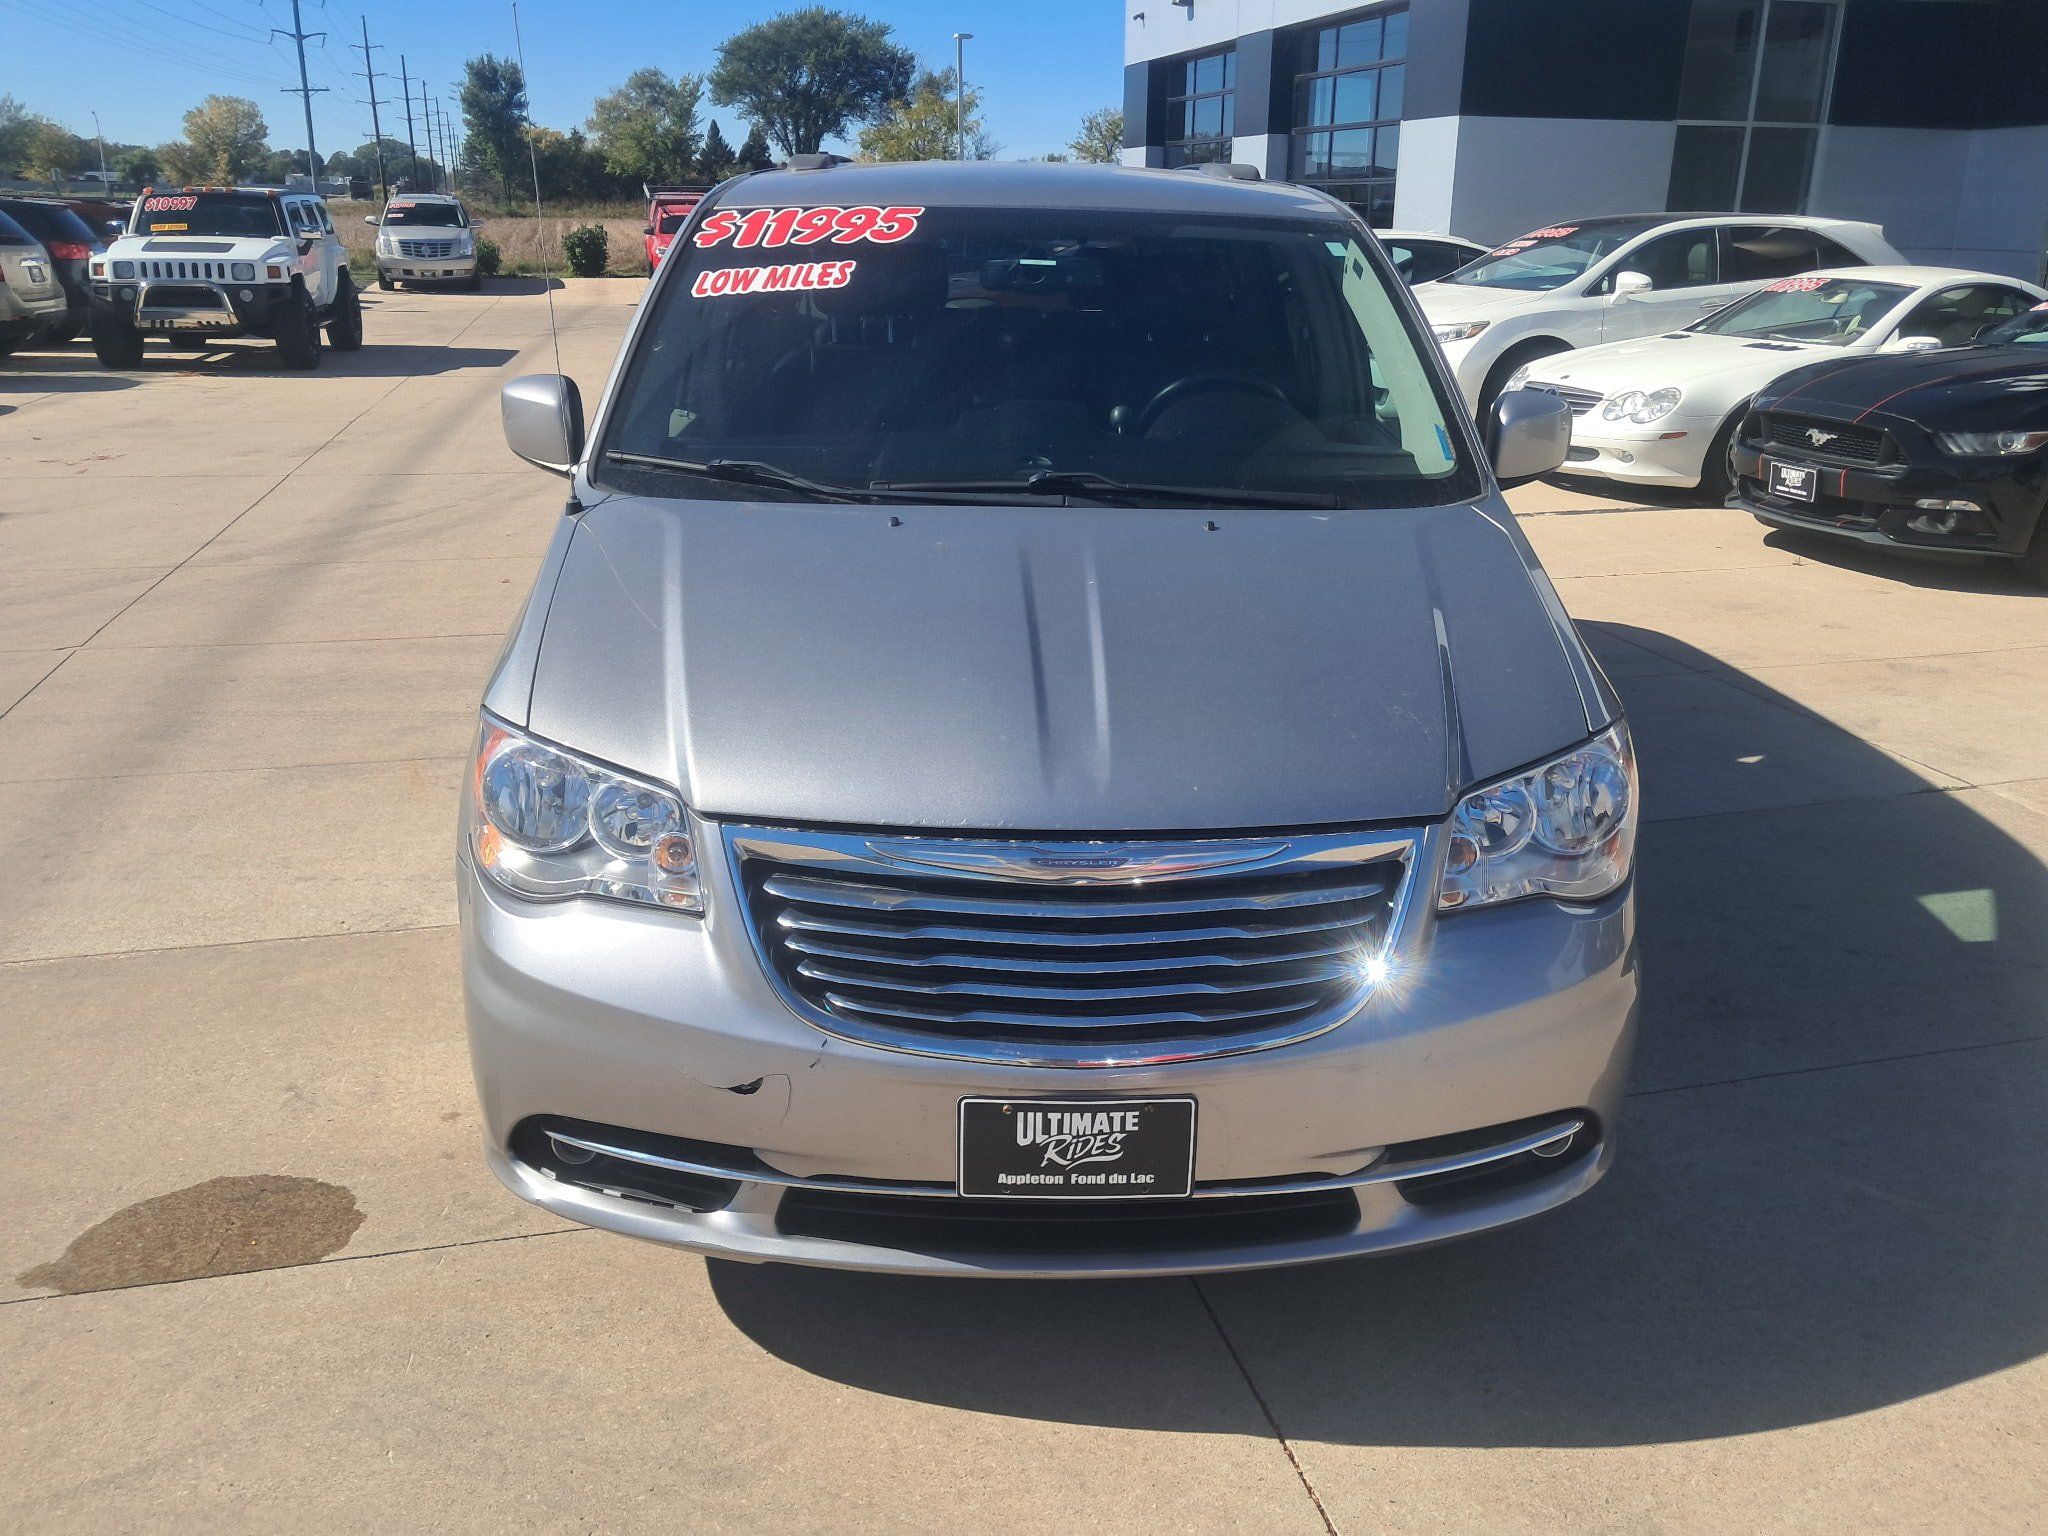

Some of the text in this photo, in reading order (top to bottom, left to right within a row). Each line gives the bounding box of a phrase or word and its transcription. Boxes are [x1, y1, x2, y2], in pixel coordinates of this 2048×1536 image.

[144, 196, 197, 211] $10997
[693, 206, 925, 248] $11995
[693, 261, 855, 297] LOW MILES
[1016, 1111, 1140, 1147] ULTIMATE
[997, 1172, 1155, 1186] Appleton Fond du Lac
